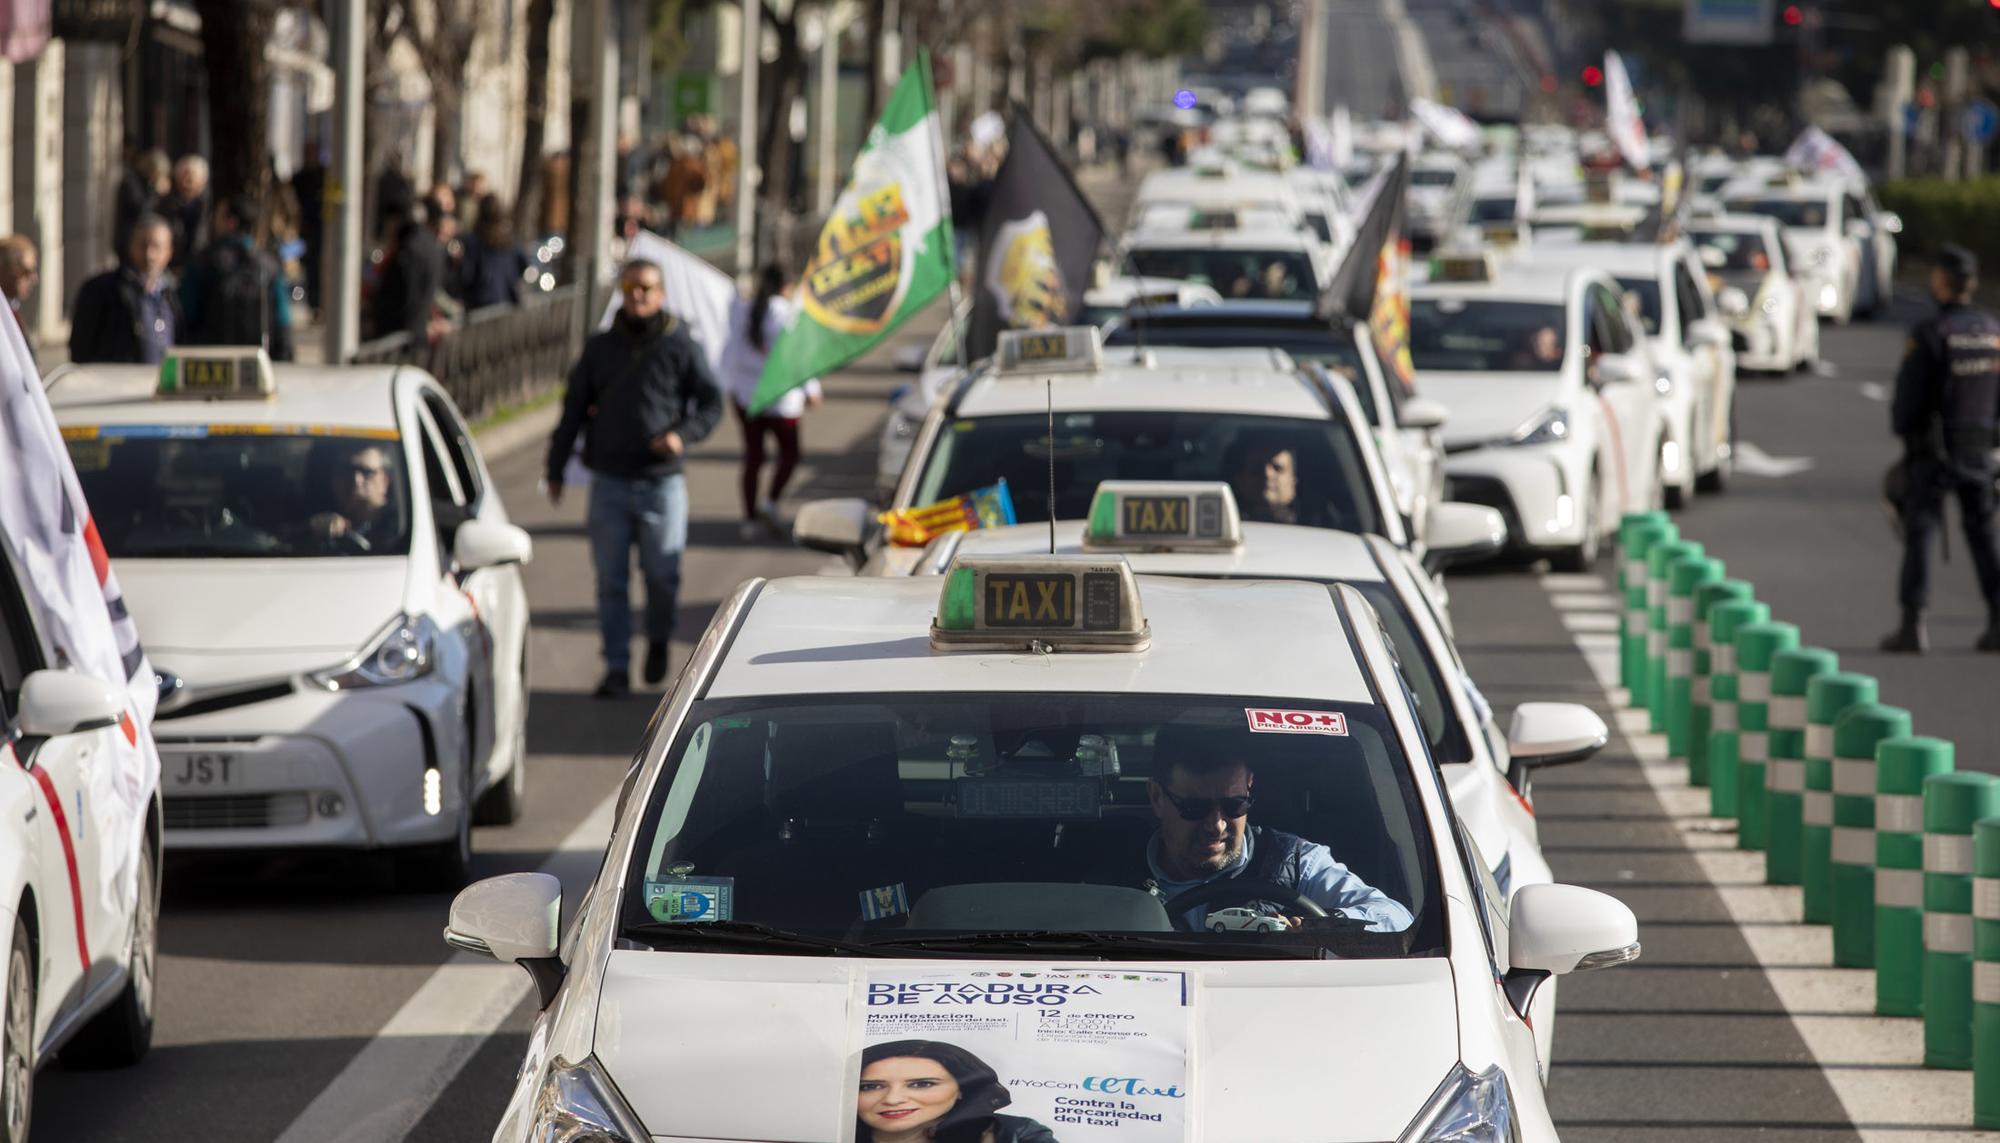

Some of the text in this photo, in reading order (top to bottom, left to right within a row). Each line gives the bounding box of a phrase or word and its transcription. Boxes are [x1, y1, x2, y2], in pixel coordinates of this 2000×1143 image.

[186, 361, 234, 384] TAXI
[1126, 501, 1188, 530] TAXI
[989, 581, 1072, 620] TAXI
[1255, 711, 1337, 726] NO+
[1257, 722, 1340, 732] PRECARIEDAD
[176, 754, 235, 785] JST
[868, 983, 1102, 995] DICTADURA
[868, 993, 1067, 1006] DE AYUSO
[1037, 1009, 1061, 1018] 12
[1008, 1079, 1078, 1090] #YoCon
[1055, 1097, 1135, 1110] Contra la
[1054, 1106, 1162, 1122] precariedad
[1054, 1115, 1119, 1127] del taxi
